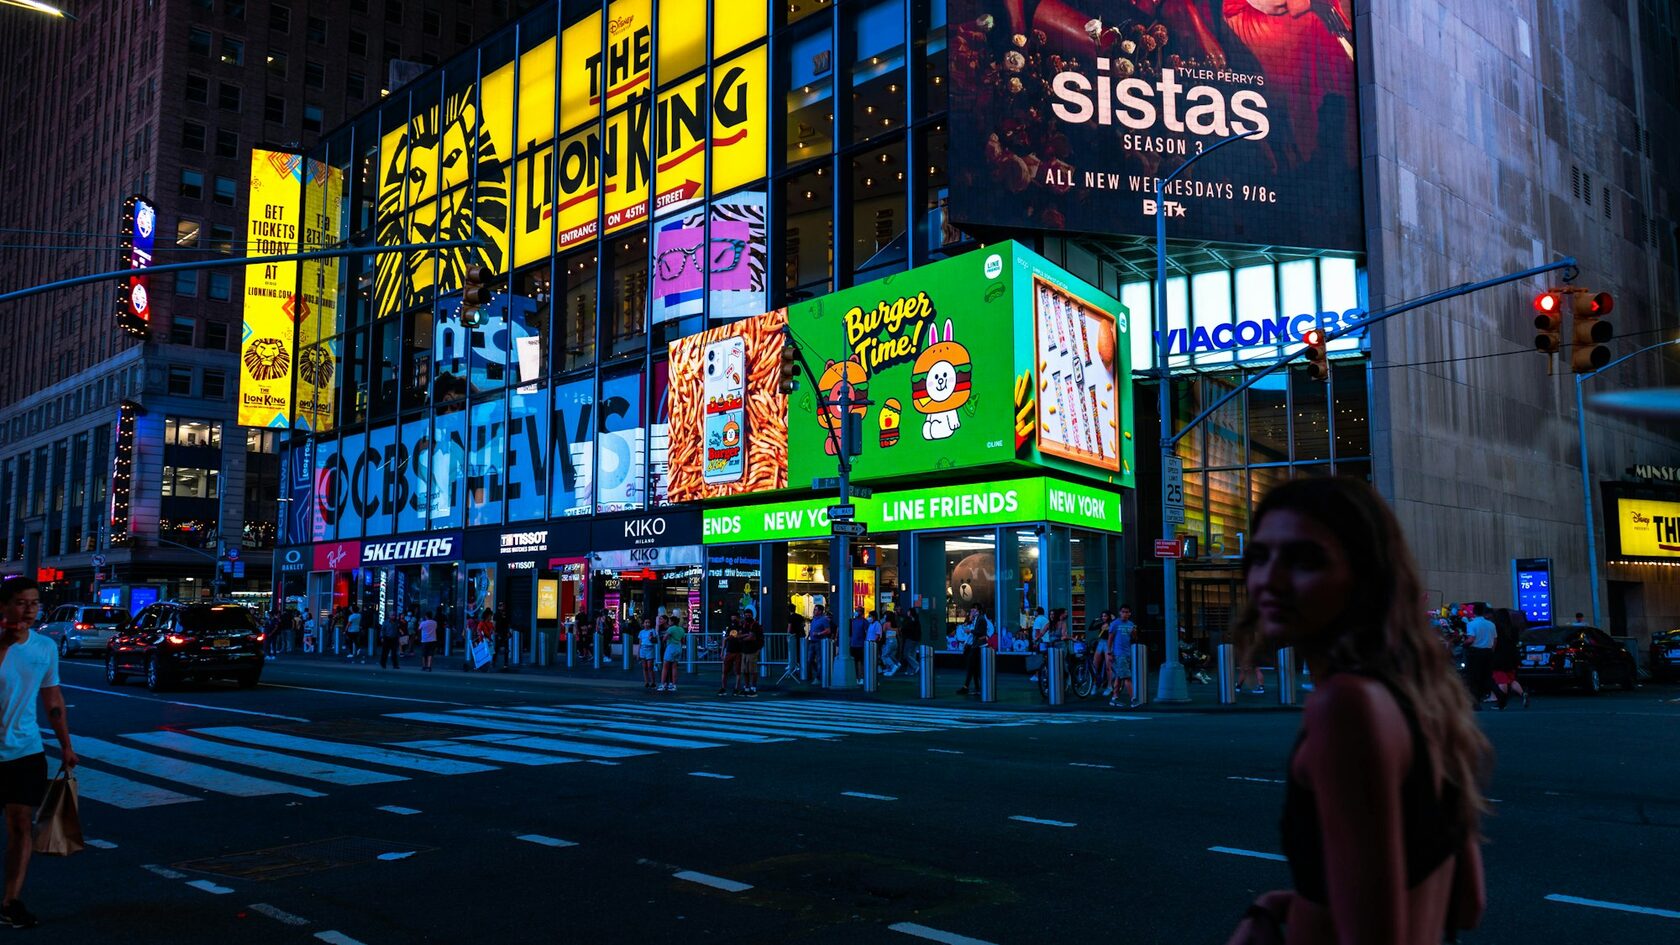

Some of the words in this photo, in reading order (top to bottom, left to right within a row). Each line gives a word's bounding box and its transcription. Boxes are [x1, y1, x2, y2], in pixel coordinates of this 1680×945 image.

[608, 14, 634, 34] Disney
[585, 24, 650, 97] THE
[1178, 66, 1213, 80] TYLER
[1217, 71, 1264, 86] PERRY'S
[1051, 57, 1270, 141] sistas
[1123, 134, 1186, 155] SEASON
[1195, 140, 1203, 155] 3
[1045, 168, 1075, 187] ALL
[1085, 171, 1120, 190] NEW
[1242, 185, 1276, 203] 9/8c
[264, 204, 284, 221] GET
[560, 222, 597, 244] ENTRANCE
[607, 211, 621, 226] ON
[625, 203, 645, 219] 45TH
[656, 189, 684, 209] STREET
[252, 220, 295, 239] TICKETS
[256, 239, 290, 256] TODAY
[264, 265, 278, 280] AT
[248, 286, 292, 299] LIONKING.COM
[843, 291, 932, 346] Burger
[1153, 308, 1365, 354] VIACOMCBS
[854, 319, 924, 373] Time!
[244, 393, 263, 405] LION
[264, 394, 286, 406] KING
[708, 446, 740, 461] Burger
[1167, 483, 1182, 503] 25
[882, 499, 925, 522] LINE
[930, 490, 1018, 518] FRIENDS
[1049, 488, 1076, 513] NEW
[1078, 494, 1106, 520] YORK
[624, 517, 666, 538] KIKO
[703, 515, 741, 535] ENDS
[763, 510, 803, 531] NEW
[1630, 511, 1650, 526] Disney
[513, 531, 548, 546] TISSOT
[362, 537, 454, 562] SKECHERS
[630, 548, 659, 561] KIKO
[515, 561, 535, 569] TISSOT
[379, 570, 387, 625] SKECHERS
